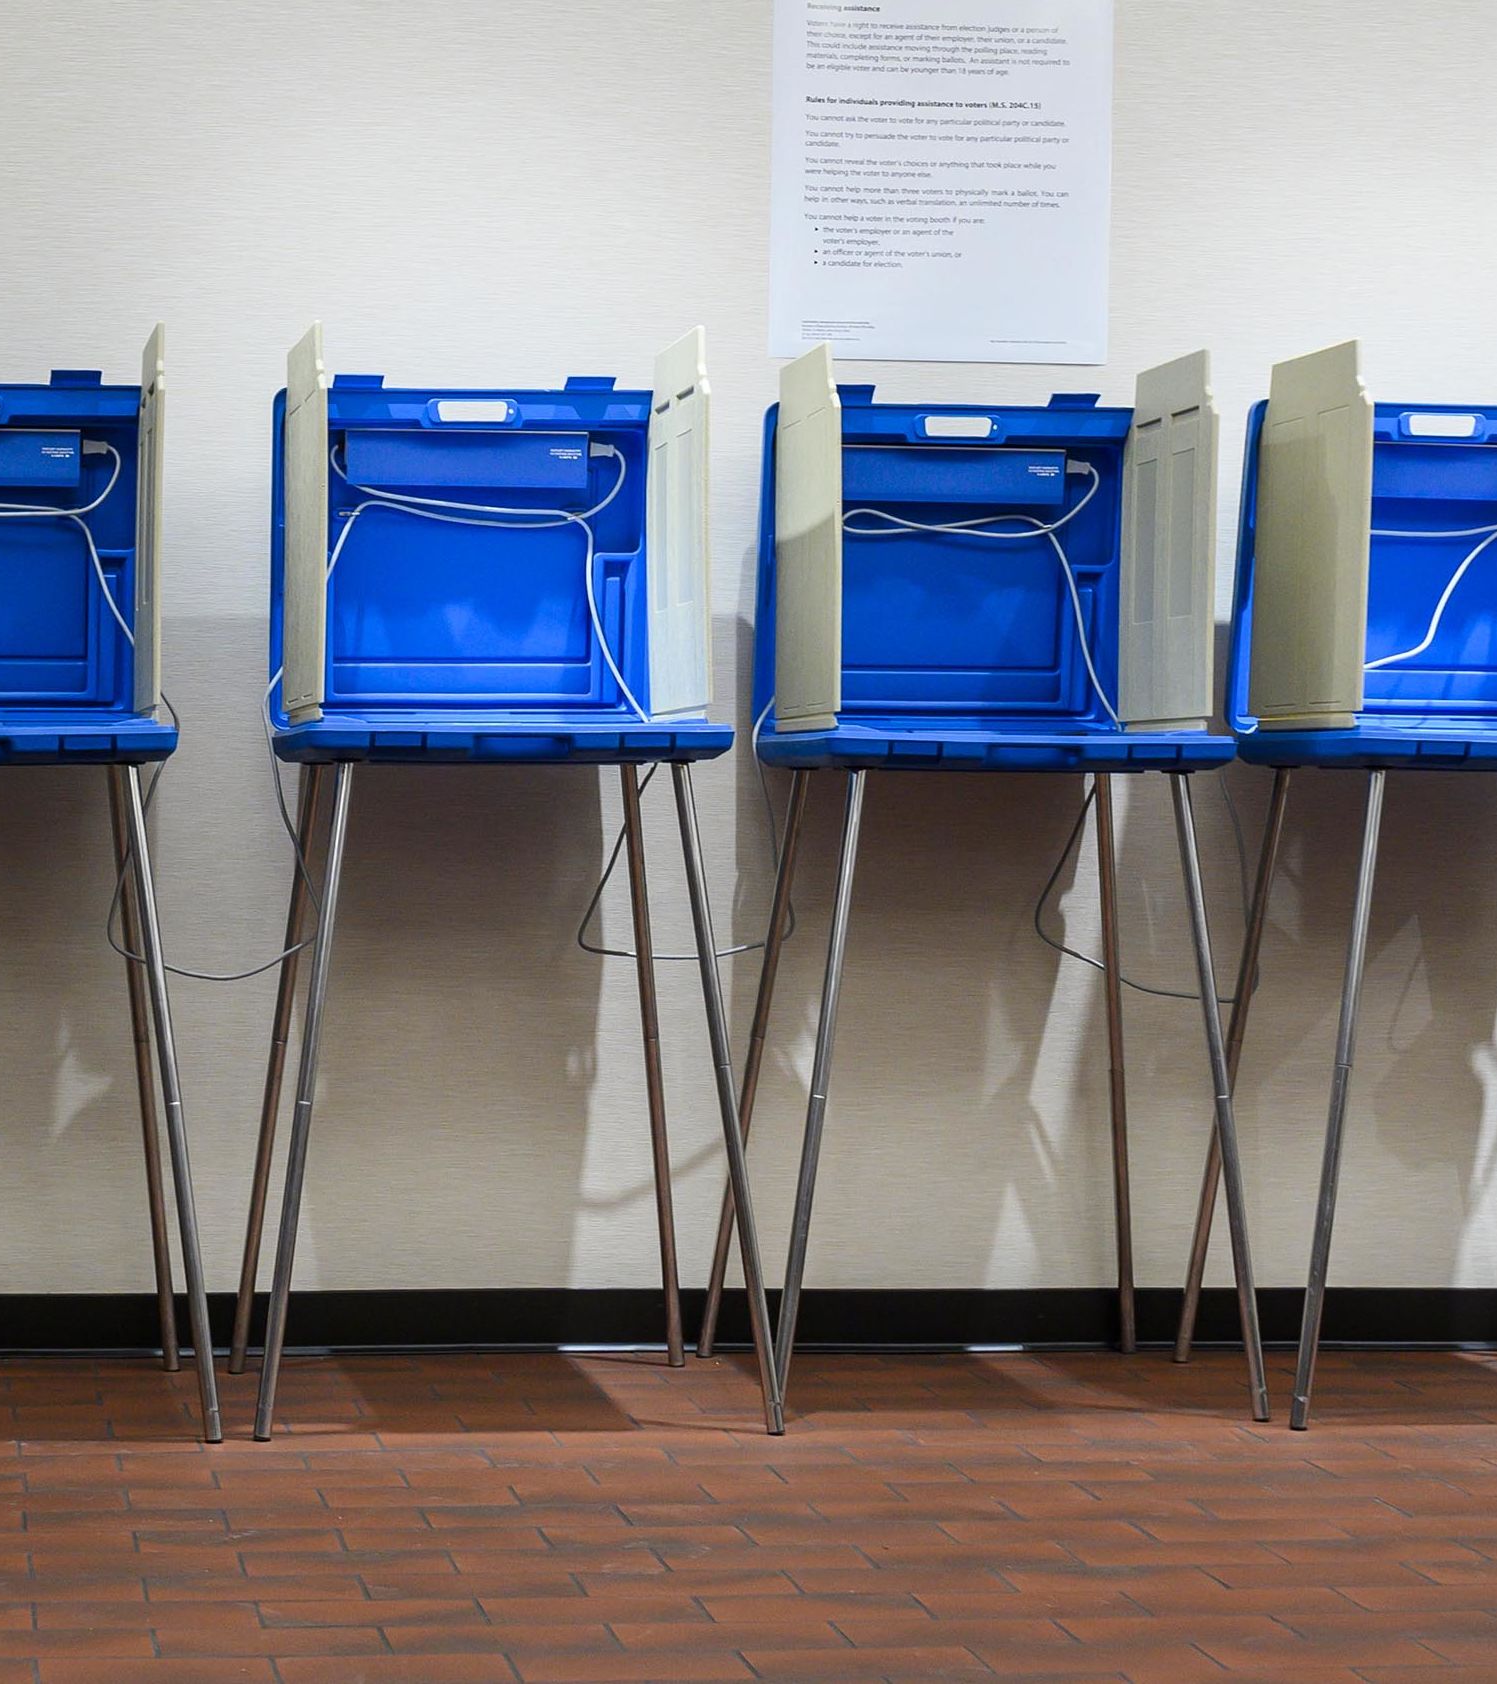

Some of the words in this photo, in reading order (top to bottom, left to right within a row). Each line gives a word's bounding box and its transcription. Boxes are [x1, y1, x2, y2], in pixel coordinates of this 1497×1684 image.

[844, 4, 880, 12] assistance
[806, 96, 825, 104] Rules
[839, 97, 878, 105] individuals
[880, 98, 915, 108] providing
[917, 99, 954, 107] assistance
